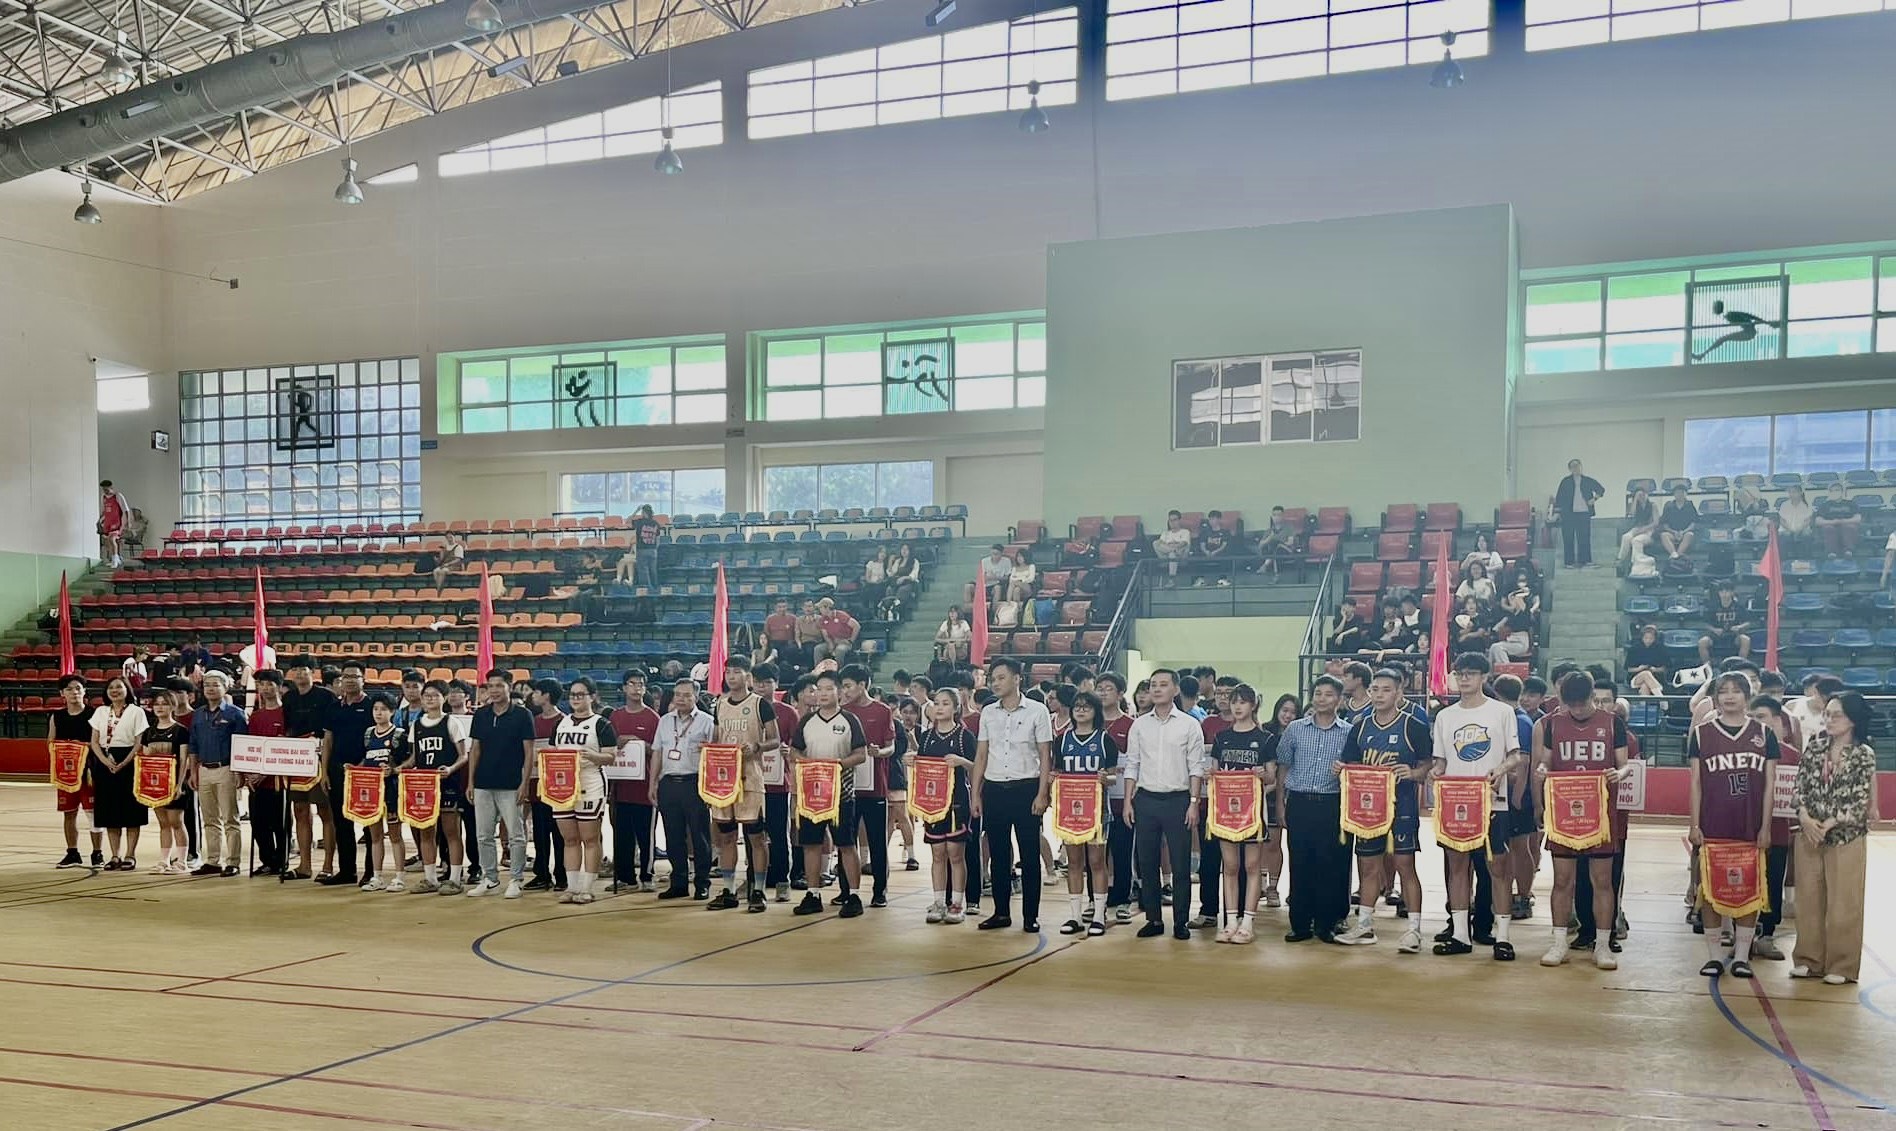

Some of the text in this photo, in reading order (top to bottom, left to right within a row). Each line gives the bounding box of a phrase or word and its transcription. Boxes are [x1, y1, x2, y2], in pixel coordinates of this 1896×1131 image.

[419, 737, 443, 753] NEU
[557, 732, 588, 745] VNU
[1363, 748, 1400, 767] HUCE
[1559, 741, 1606, 761] UEB
[426, 753, 435, 766] 17
[1063, 756, 1100, 772] TLU
[1705, 752, 1766, 772] UNETI
